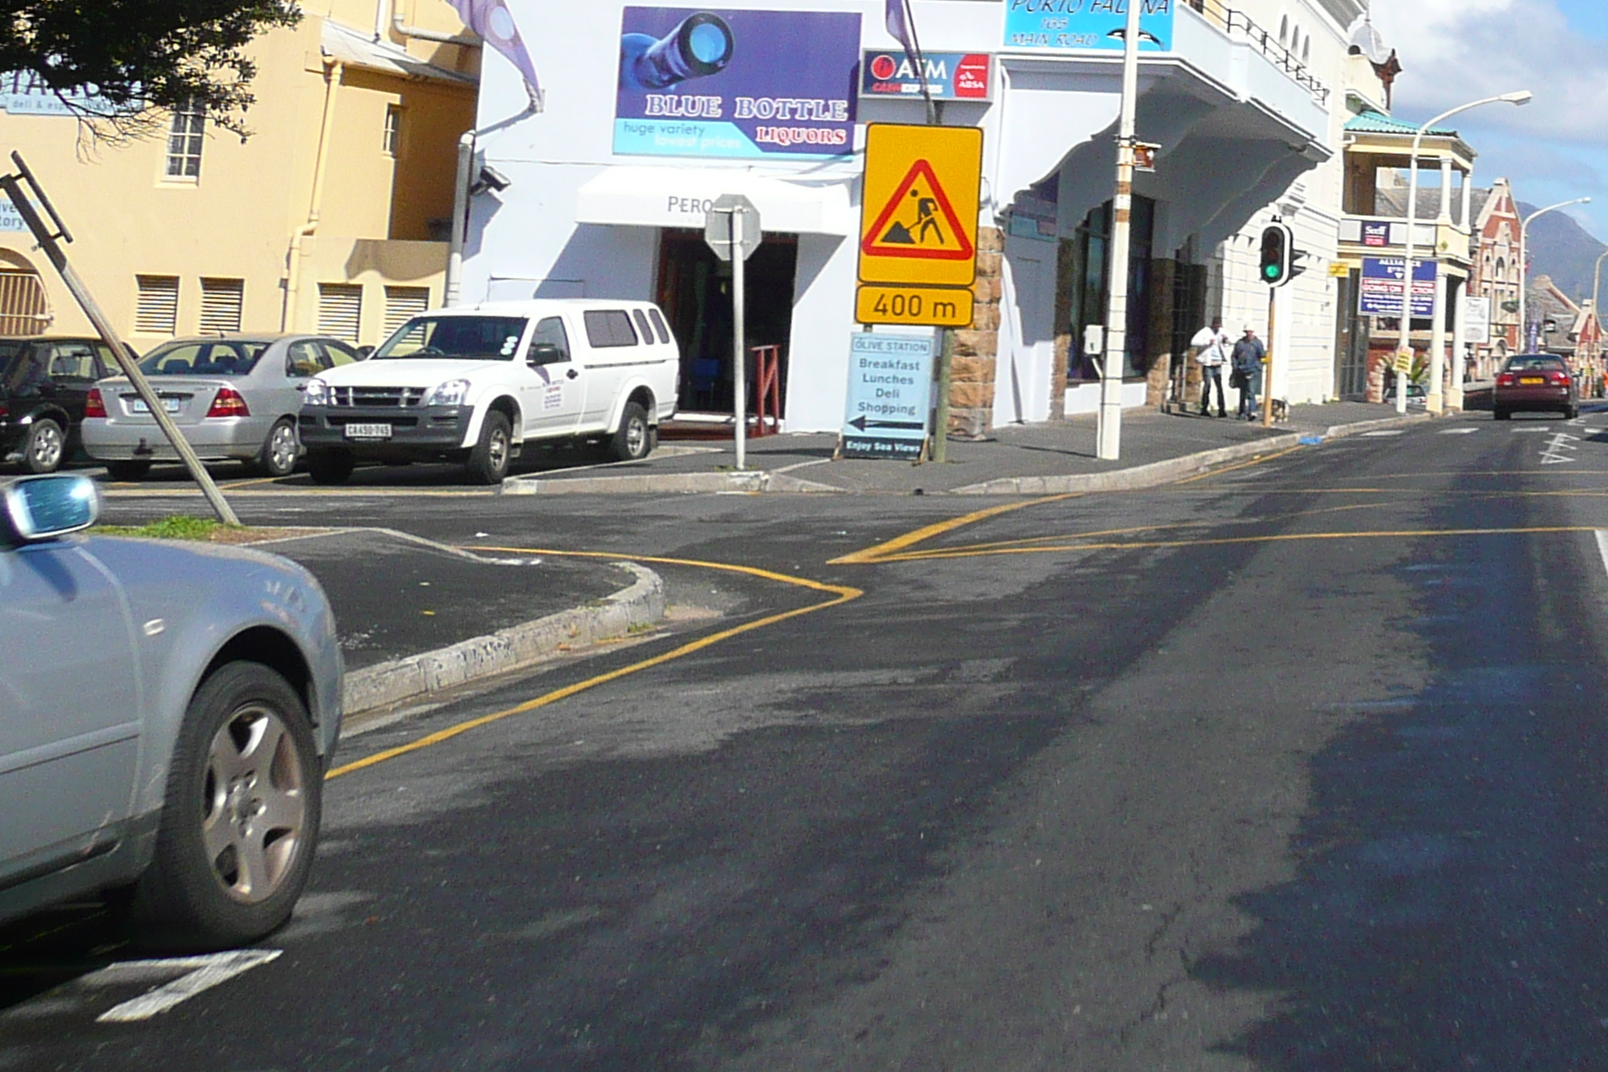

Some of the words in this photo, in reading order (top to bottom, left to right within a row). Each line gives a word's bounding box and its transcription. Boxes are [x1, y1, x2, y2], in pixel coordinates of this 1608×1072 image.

[1011, 33, 1051, 45] MAIN
[1055, 33, 1097, 46] ROAD
[645, 94, 722, 117] BLUE
[735, 96, 848, 121] BOTTLE
[623, 121, 655, 134] huge
[660, 123, 706, 137] variety
[755, 126, 847, 146] LIQUORS
[667, 196, 714, 214] PERO
[873, 294, 922, 317] 400
[932, 301, 956, 319] m
[855, 339, 883, 351] OLIVE
[886, 341, 928, 352] STATION
[859, 358, 920, 371] Breakfast
[862, 373, 914, 385] Lunches
[875, 388, 900, 399] Deli
[858, 402, 916, 416] Shopping
[846, 440, 873, 452] Enjoy
[874, 442, 892, 451] Sea
[894, 442, 921, 453] Views
